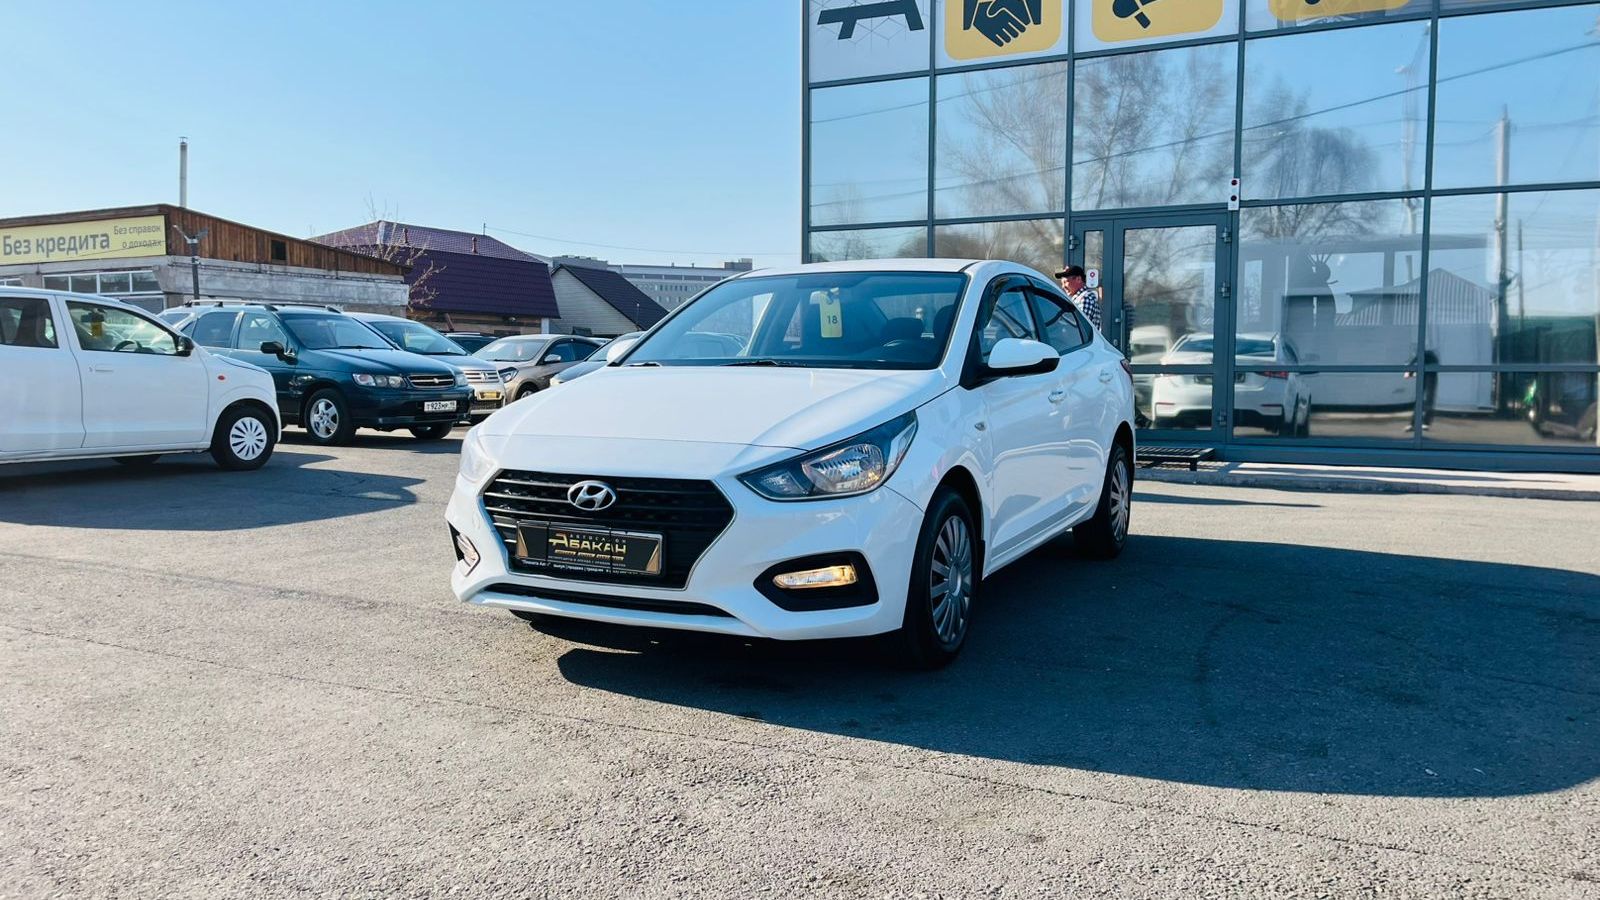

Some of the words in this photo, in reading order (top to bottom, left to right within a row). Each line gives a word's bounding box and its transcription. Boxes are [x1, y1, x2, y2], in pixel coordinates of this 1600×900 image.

[113, 225, 128, 235] Без
[129, 225, 161, 236] справок
[2, 234, 32, 256] Без
[36, 232, 110, 258] кредита
[827, 315, 838, 325] 18
[569, 533, 627, 543] АВТОСАОН
